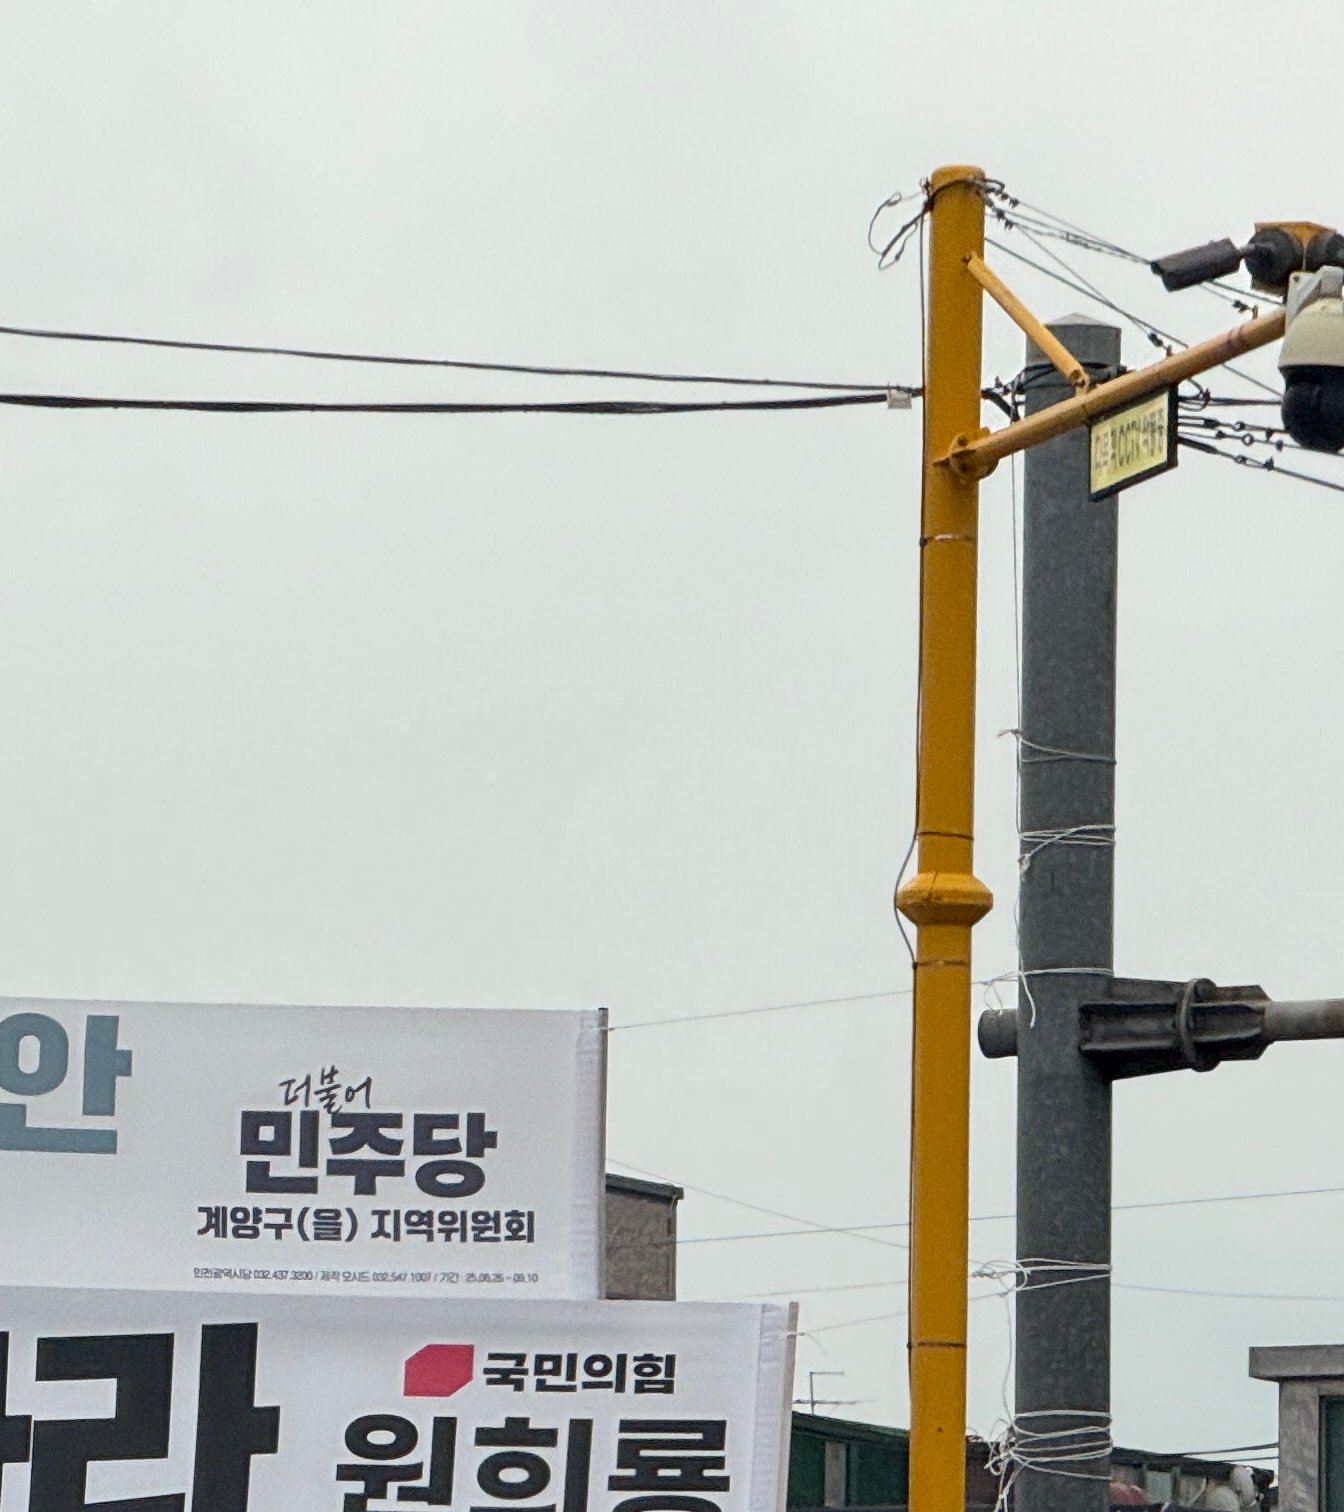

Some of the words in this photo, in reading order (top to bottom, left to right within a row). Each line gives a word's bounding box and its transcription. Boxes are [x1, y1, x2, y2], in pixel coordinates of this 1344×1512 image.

[279, 1065, 373, 1113] 더불어
[239, 1110, 499, 1198] 민주당
[196, 1205, 359, 1243] 계양구(을)
[370, 1209, 536, 1244] 지역위원회
[482, 1351, 677, 1395] 국민의힘
